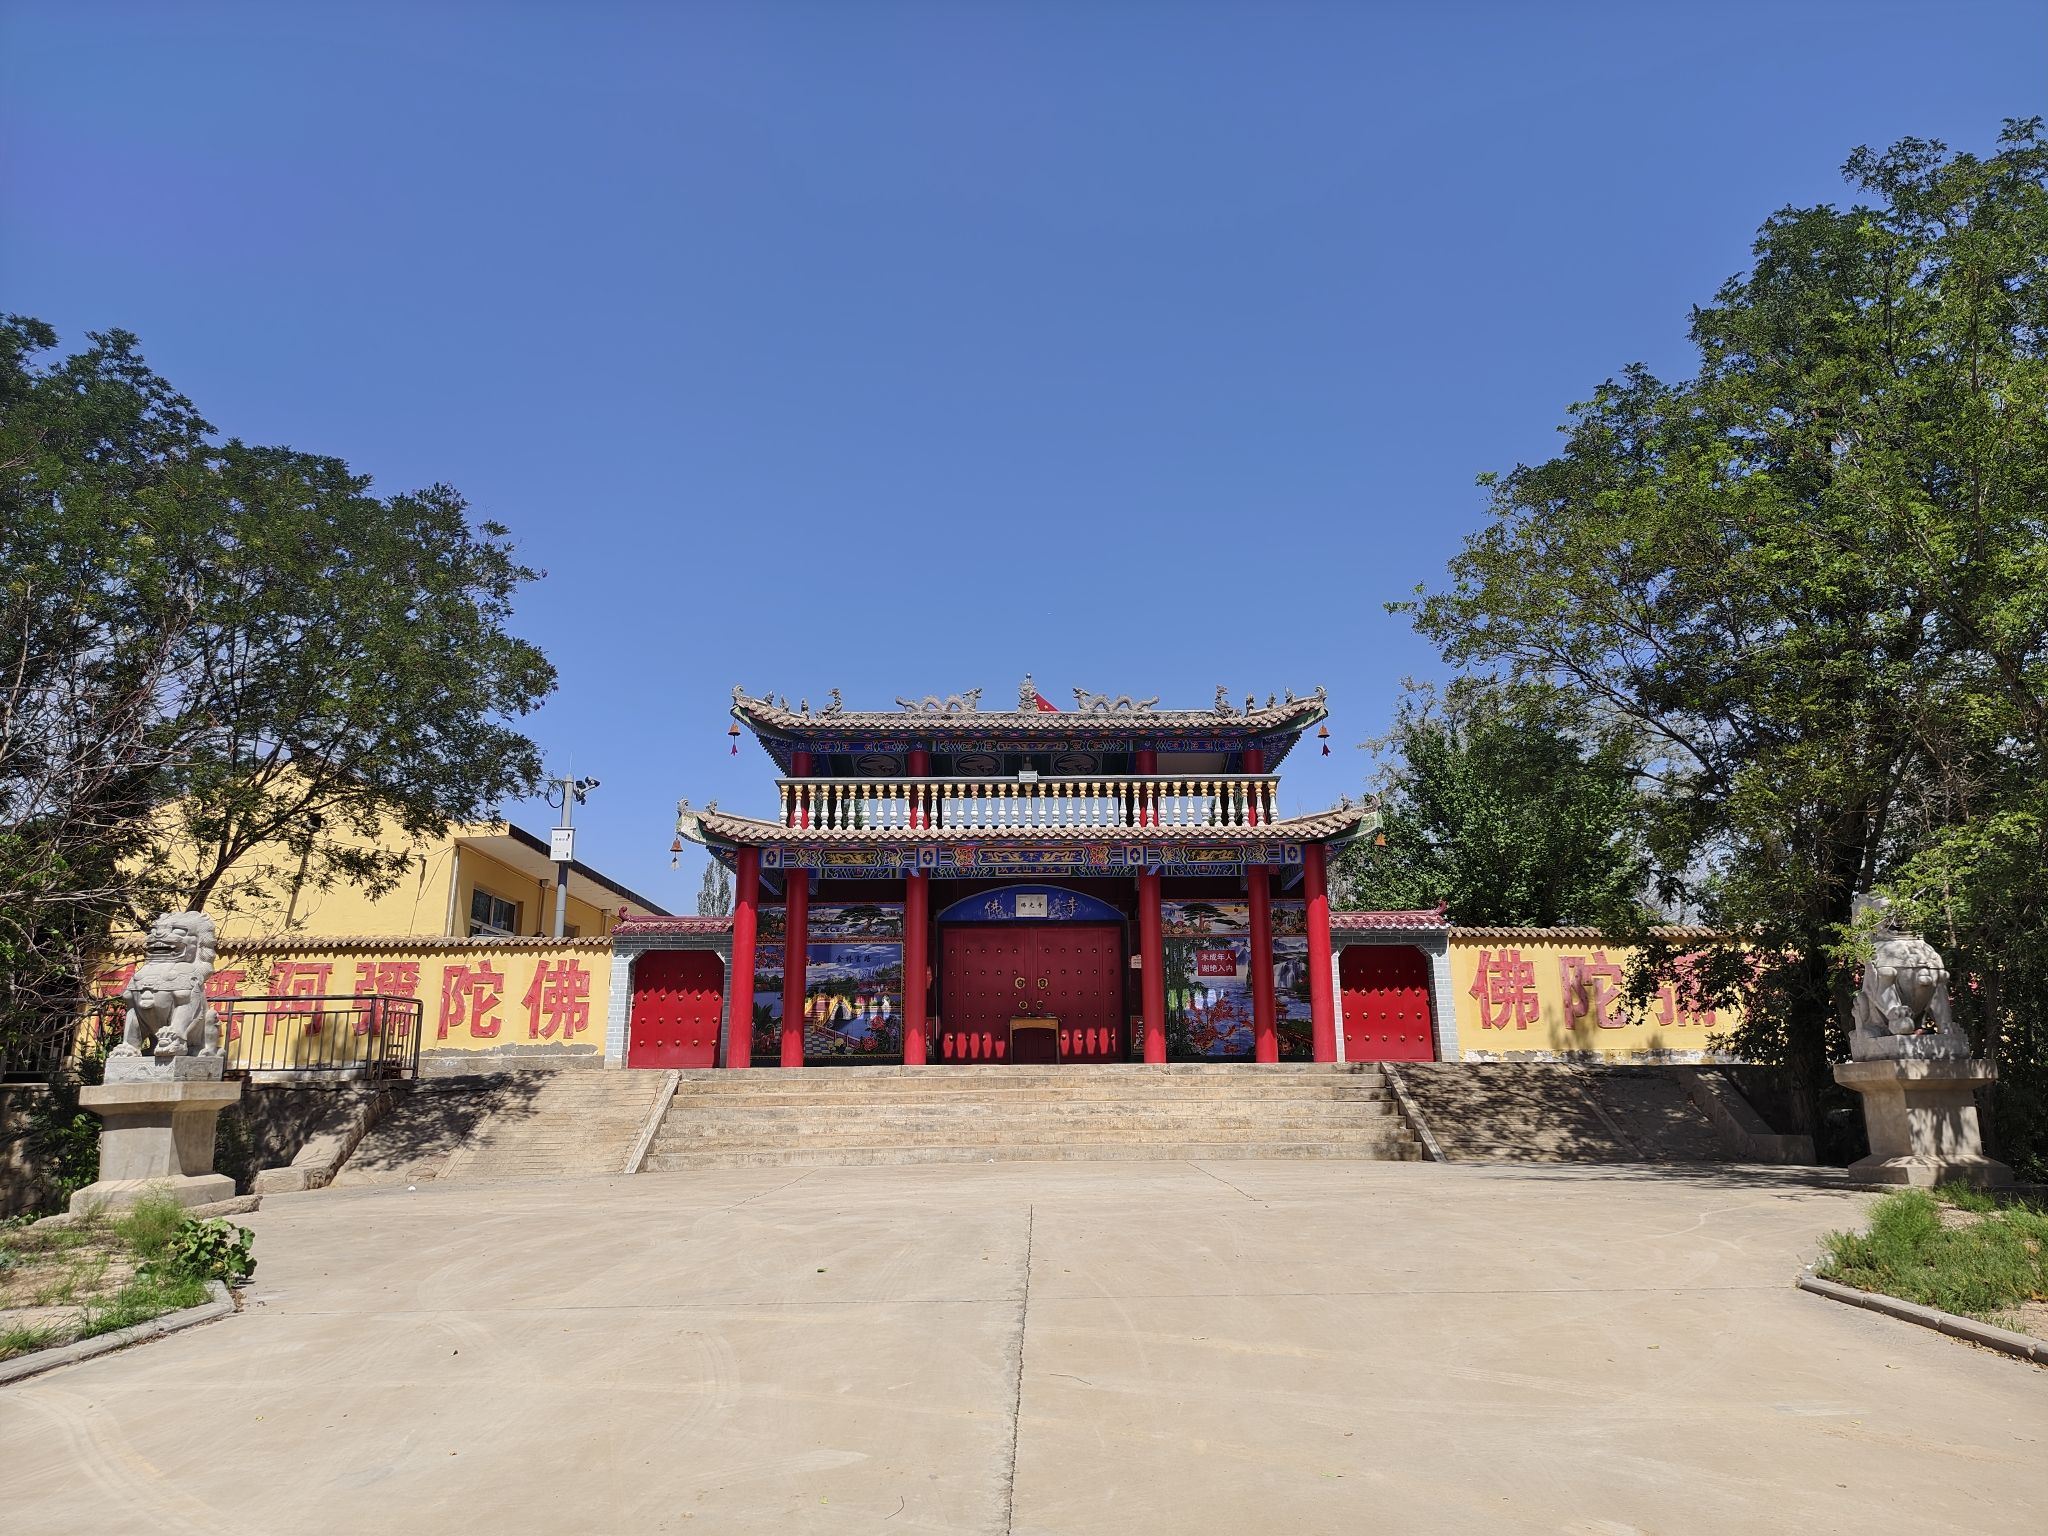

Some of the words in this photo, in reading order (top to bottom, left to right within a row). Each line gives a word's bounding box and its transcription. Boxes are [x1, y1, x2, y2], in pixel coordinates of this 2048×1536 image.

[1201, 953, 1233, 961] 未成年人
[1201, 964, 1233, 972] 谢绝入内
